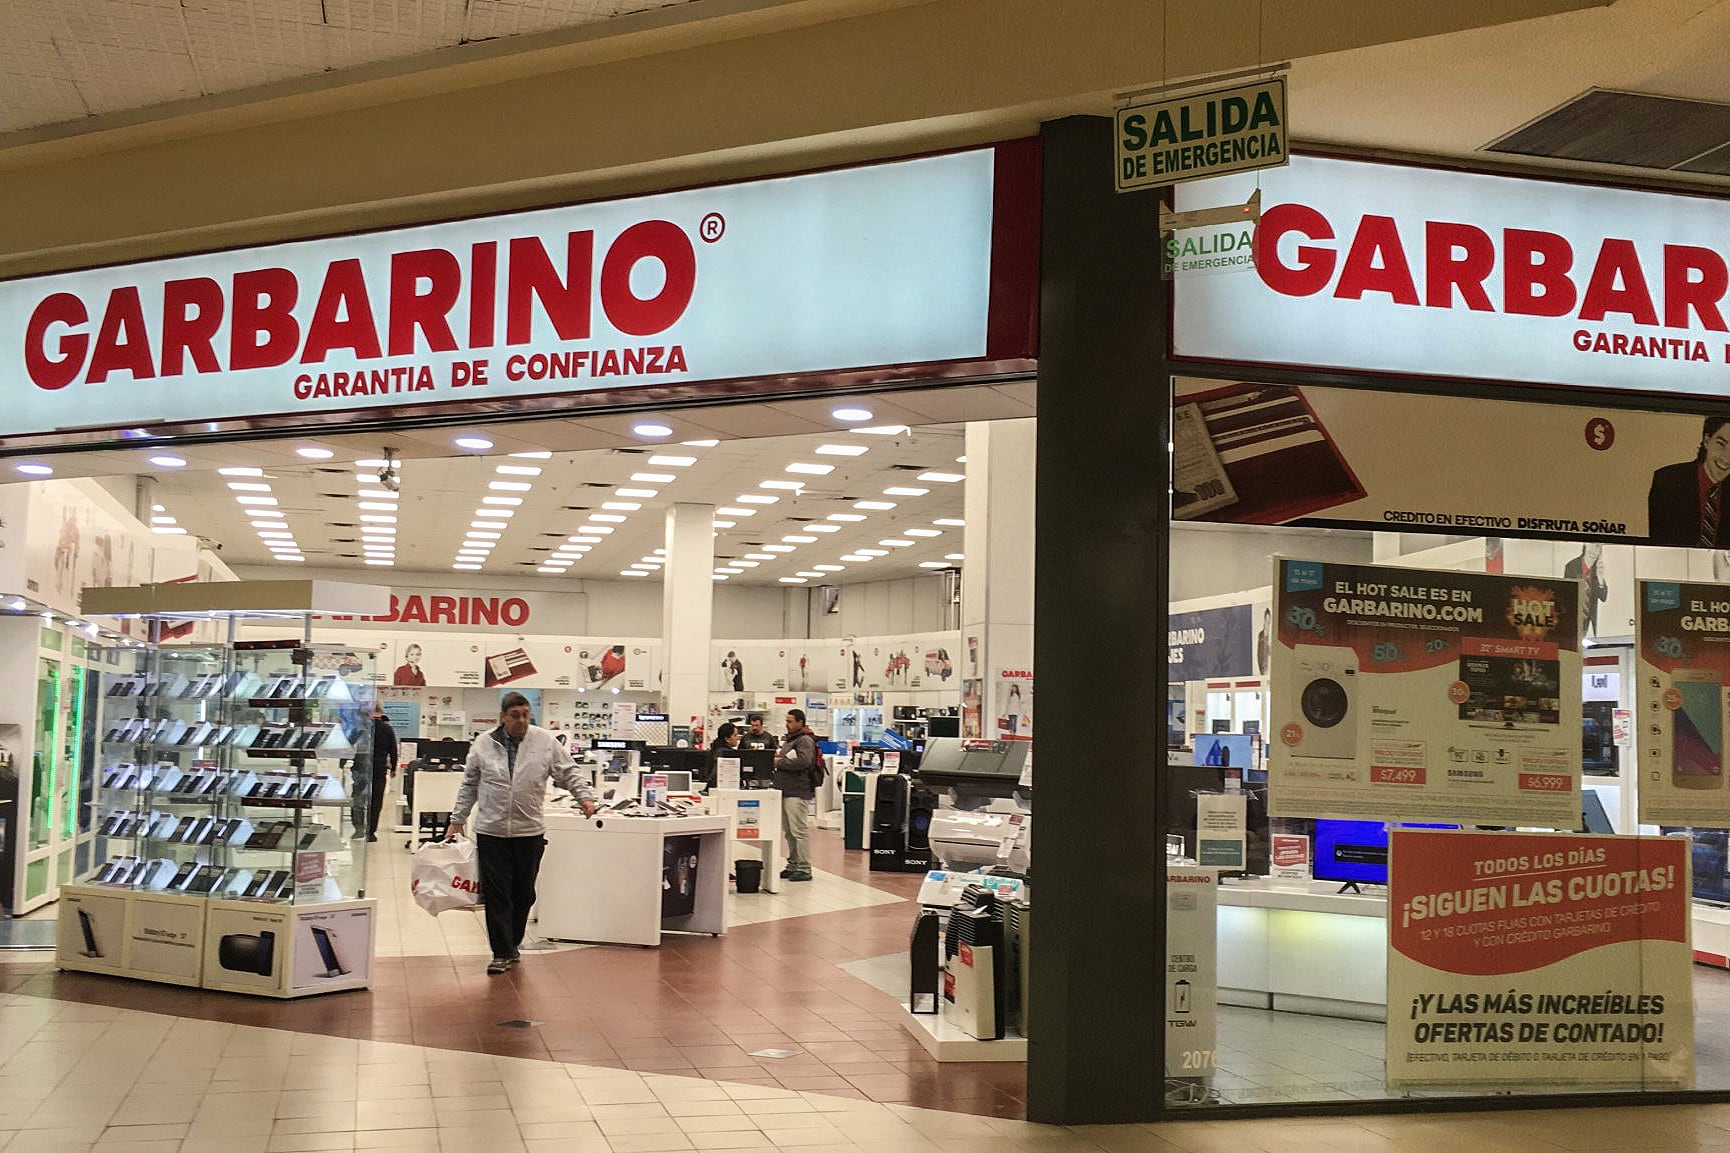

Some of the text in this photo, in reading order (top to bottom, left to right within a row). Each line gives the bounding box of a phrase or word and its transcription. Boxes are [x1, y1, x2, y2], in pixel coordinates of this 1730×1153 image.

[1123, 91, 1279, 151] SALIDA
[1124, 132, 1280, 180] DE EMERGENCIA
[1166, 231, 1252, 258] SALIDA
[1163, 255, 1256, 273] DE EMERGENCIA
[1254, 203, 1730, 332] GARBAR
[25, 219, 696, 390] GARBARINO
[1573, 330, 1710, 363] GARANTIA
[294, 346, 688, 400] GARANTIA DE CONFIANZA
[1384, 511, 1626, 534] CREDITO EN EFECTIVO DISFRUTA SOÑAR
[1335, 582, 1472, 602] EL HOT SALE ES EN
[1323, 597, 1483, 623] GARBARINO.COM
[1513, 599, 1555, 616] HOT
[1691, 600, 1707, 613] EL
[1515, 614, 1554, 627] SALE
[1681, 616, 1730, 632] GARB
[1495, 644, 1526, 655] SMART
[1528, 647, 1540, 655] TV
[1380, 768, 1417, 783] $7.499
[1528, 776, 1563, 789] $6.999
[1474, 847, 1606, 876] TODOS LOS DÍAS
[1403, 865, 1674, 927] ¡SIGUEN LAS CUOTAS!
[1421, 929, 1433, 941] 12
[1434, 928, 1441, 939] Y
[1456, 920, 1495, 936] CUOTAS
[1498, 917, 1527, 931] FIJAS
[1528, 915, 1551, 928] CON
[1553, 909, 1602, 922] TARJETAS
[1605, 906, 1618, 918] DE
[1473, 938, 1480, 947] Y
[1482, 935, 1504, 947] CON
[1553, 922, 1611, 939] GARBARINO
[1168, 964, 1198, 973] DE CARGA
[1171, 955, 1195, 963] CENTRO
[1411, 989, 1665, 1019] ¡Y LAS MÁS INCREÍBLES
[1414, 1023, 1664, 1043] OFERTAS DE CONTADO!
